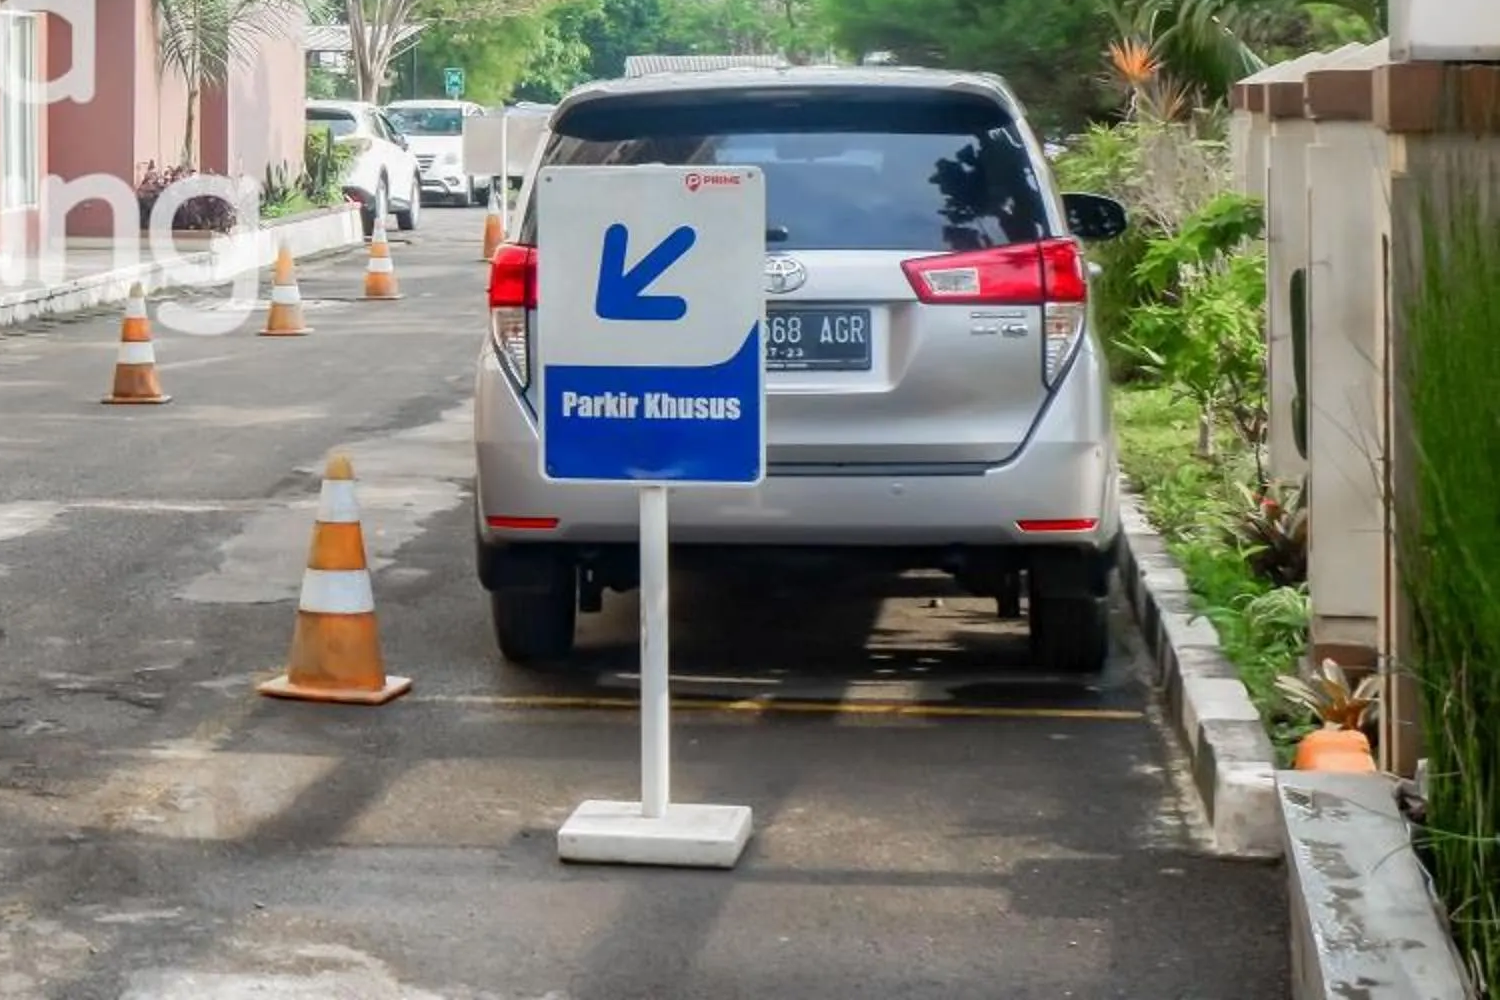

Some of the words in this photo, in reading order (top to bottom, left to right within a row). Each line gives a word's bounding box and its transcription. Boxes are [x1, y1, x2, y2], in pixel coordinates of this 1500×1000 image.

[703, 175, 741, 185] PRIME
[819, 315, 866, 344] AGR
[562, 391, 640, 418] Parkir
[643, 392, 741, 420] Khusus
